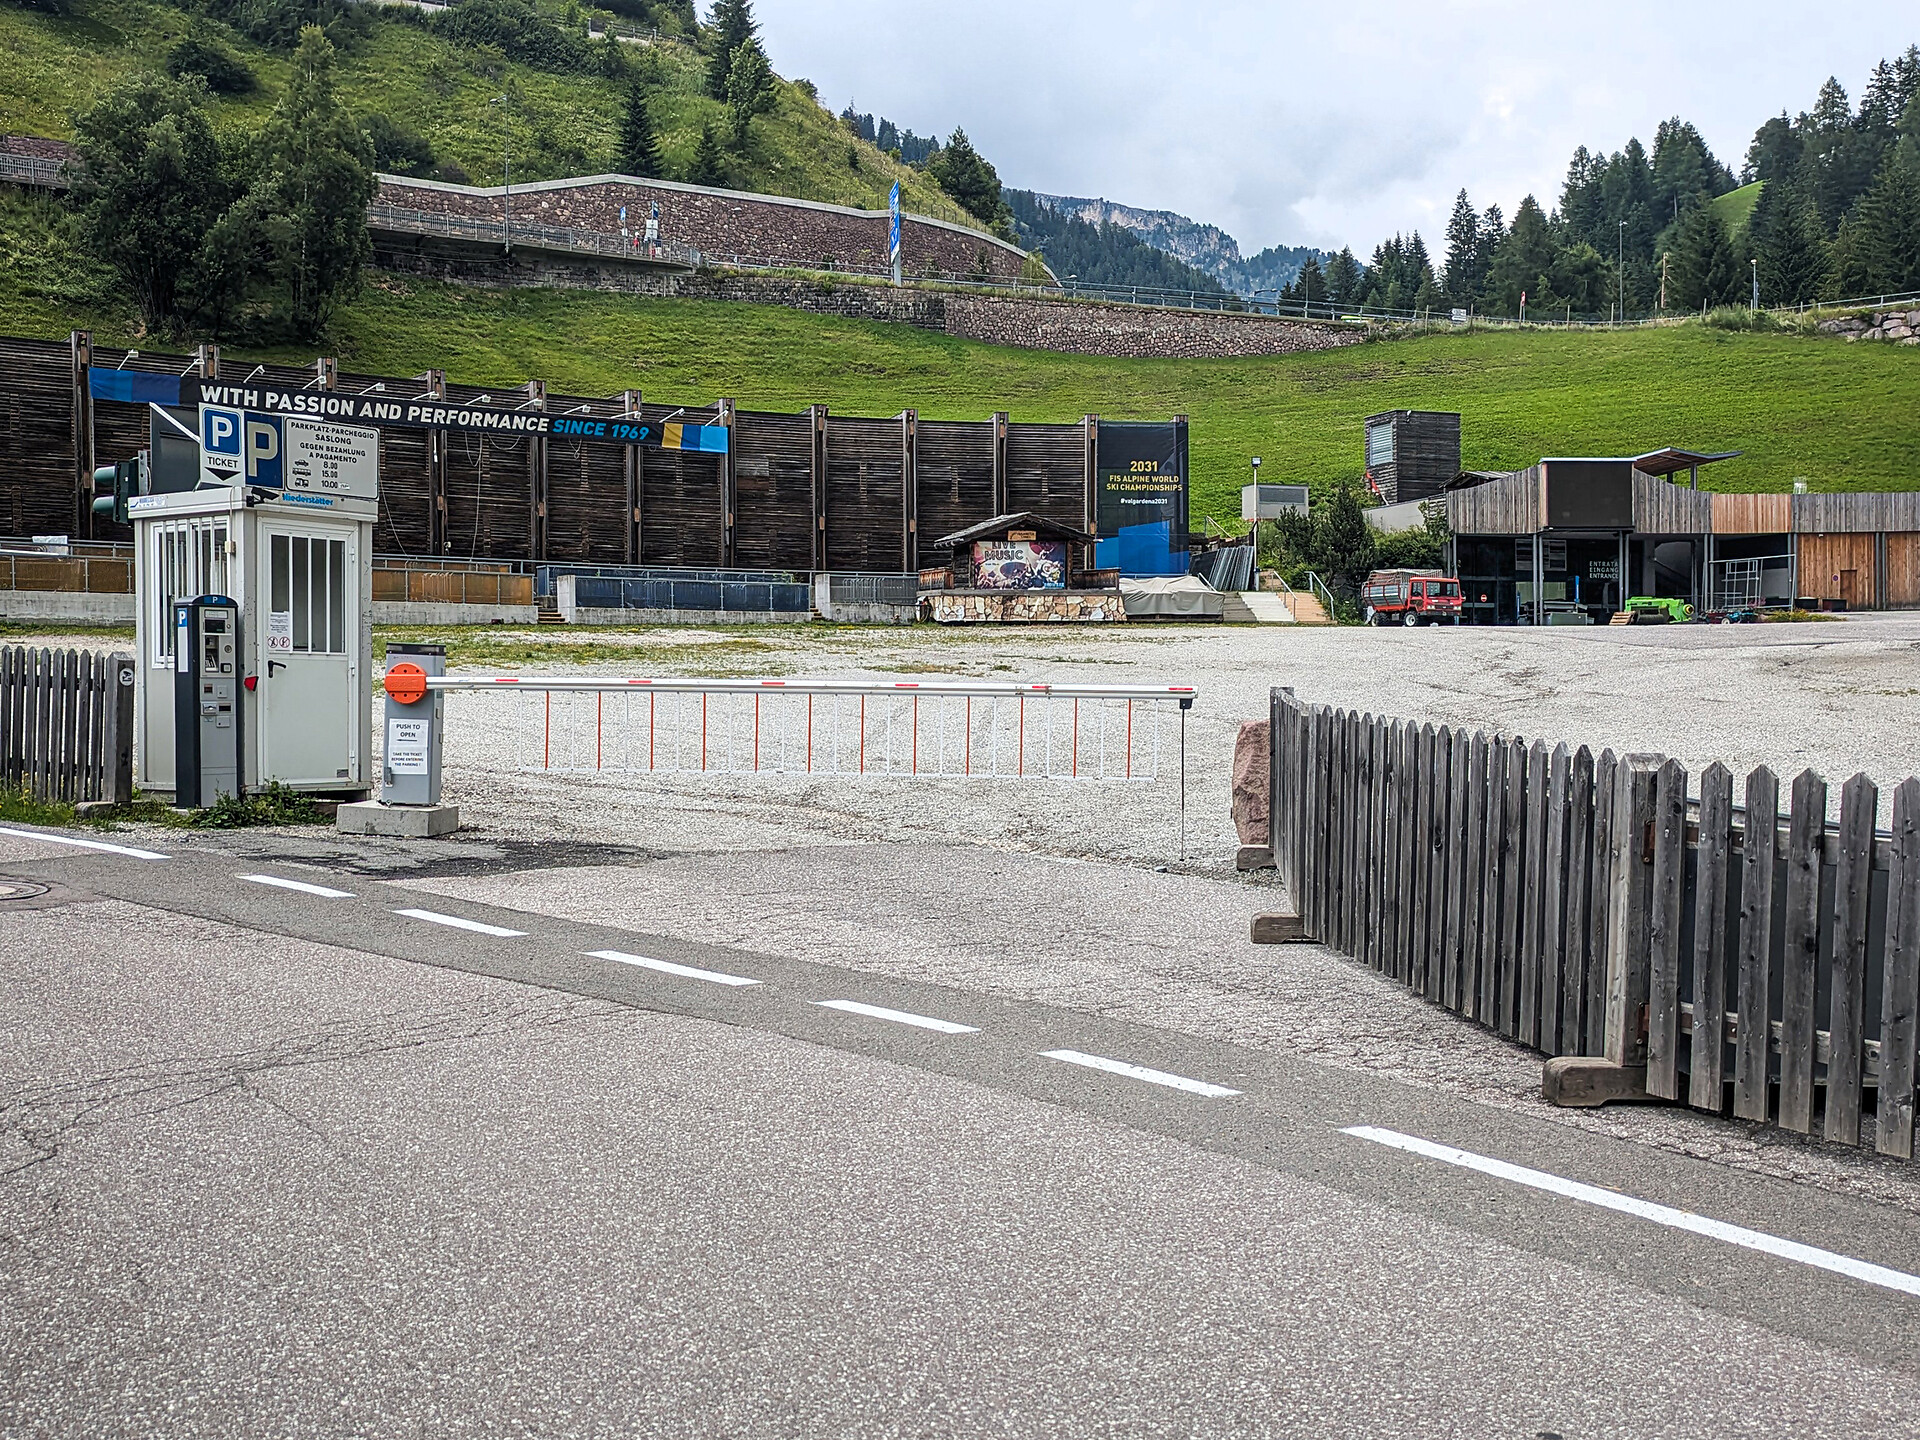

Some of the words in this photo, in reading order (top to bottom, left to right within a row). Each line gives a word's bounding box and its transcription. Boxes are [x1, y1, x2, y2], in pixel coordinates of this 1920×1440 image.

[200, 385, 258, 408] WITH
[265, 392, 355, 416] PASSION
[358, 401, 402, 421] AND
[407, 406, 550, 432] PERFORMANCE
[552, 419, 607, 436] SINCE
[611, 424, 650, 440] 1969
[211, 415, 234, 448] P
[290, 421, 375, 440] PARKPLATZ-PARCHEGGIO
[315, 433, 352, 445] SASLONG
[246, 420, 278, 478] P
[299, 442, 324, 452] GEGEN
[325, 445, 366, 457] BEZAHLUNG
[207, 456, 239, 469] TICKET
[315, 452, 358, 464] PAGAMENTO
[323, 461, 338, 470] 8.00
[1130, 460, 1158, 472] 2031
[321, 470, 338, 479] 15.00
[1109, 474, 1121, 482] FIS
[1122, 475, 1150, 483] ALPINE
[1151, 475, 1180, 483] WORLD
[321, 479, 339, 489] 10.00
[1106, 483, 1119, 491] SKI
[1120, 484, 1183, 492] CHAMPIONSHIPS
[282, 492, 334, 506] Niederstätter
[991, 541, 1016, 550] LIVE
[984, 549, 1024, 561] MUSIC
[212, 596, 218, 604] P
[178, 610, 187, 625] P
